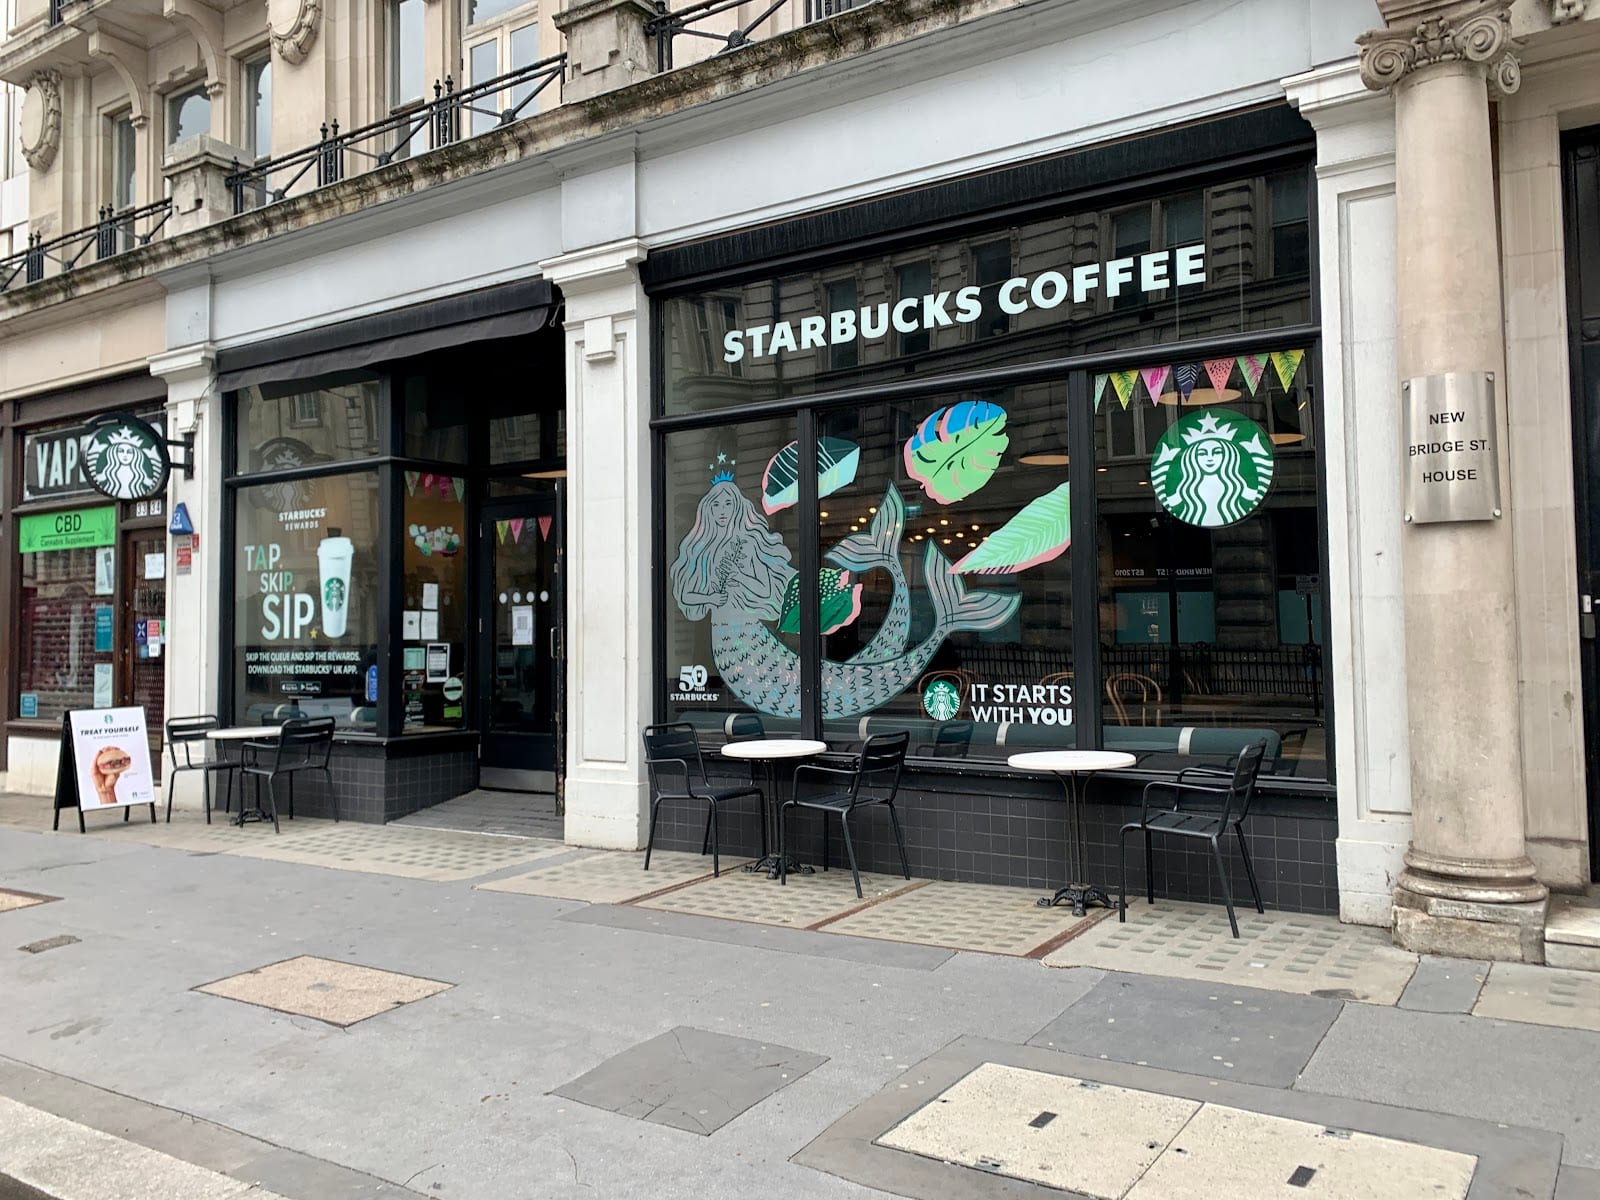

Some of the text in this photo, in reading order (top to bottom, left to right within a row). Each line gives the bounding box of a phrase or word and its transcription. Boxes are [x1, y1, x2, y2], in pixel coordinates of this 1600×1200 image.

[722, 243, 1207, 364] STARBUCKS COFFEE
[1429, 411, 1465, 425] NEW
[1409, 439, 1491, 456] BRIDGE ST.
[1422, 469, 1477, 483] HOUSE
[279, 508, 326, 522] STARBUCKS
[55, 514, 82, 533] CBD
[285, 520, 319, 531] REWARDS
[246, 651, 361, 662] SKIP THE QUEUE AND SIP THE REWARDS.
[248, 665, 283, 675] DOWNLOAD
[283, 665, 294, 674] THE
[333, 665, 343, 674] UK
[343, 665, 358, 674] APP.
[679, 664, 708, 692] 50
[670, 693, 718, 701] STARBUCKS
[971, 684, 1072, 704] IT STARTS
[970, 705, 1073, 726] WITH YOU
[80, 729, 102, 737] TREAT
[104, 726, 140, 735] YOURSELF
